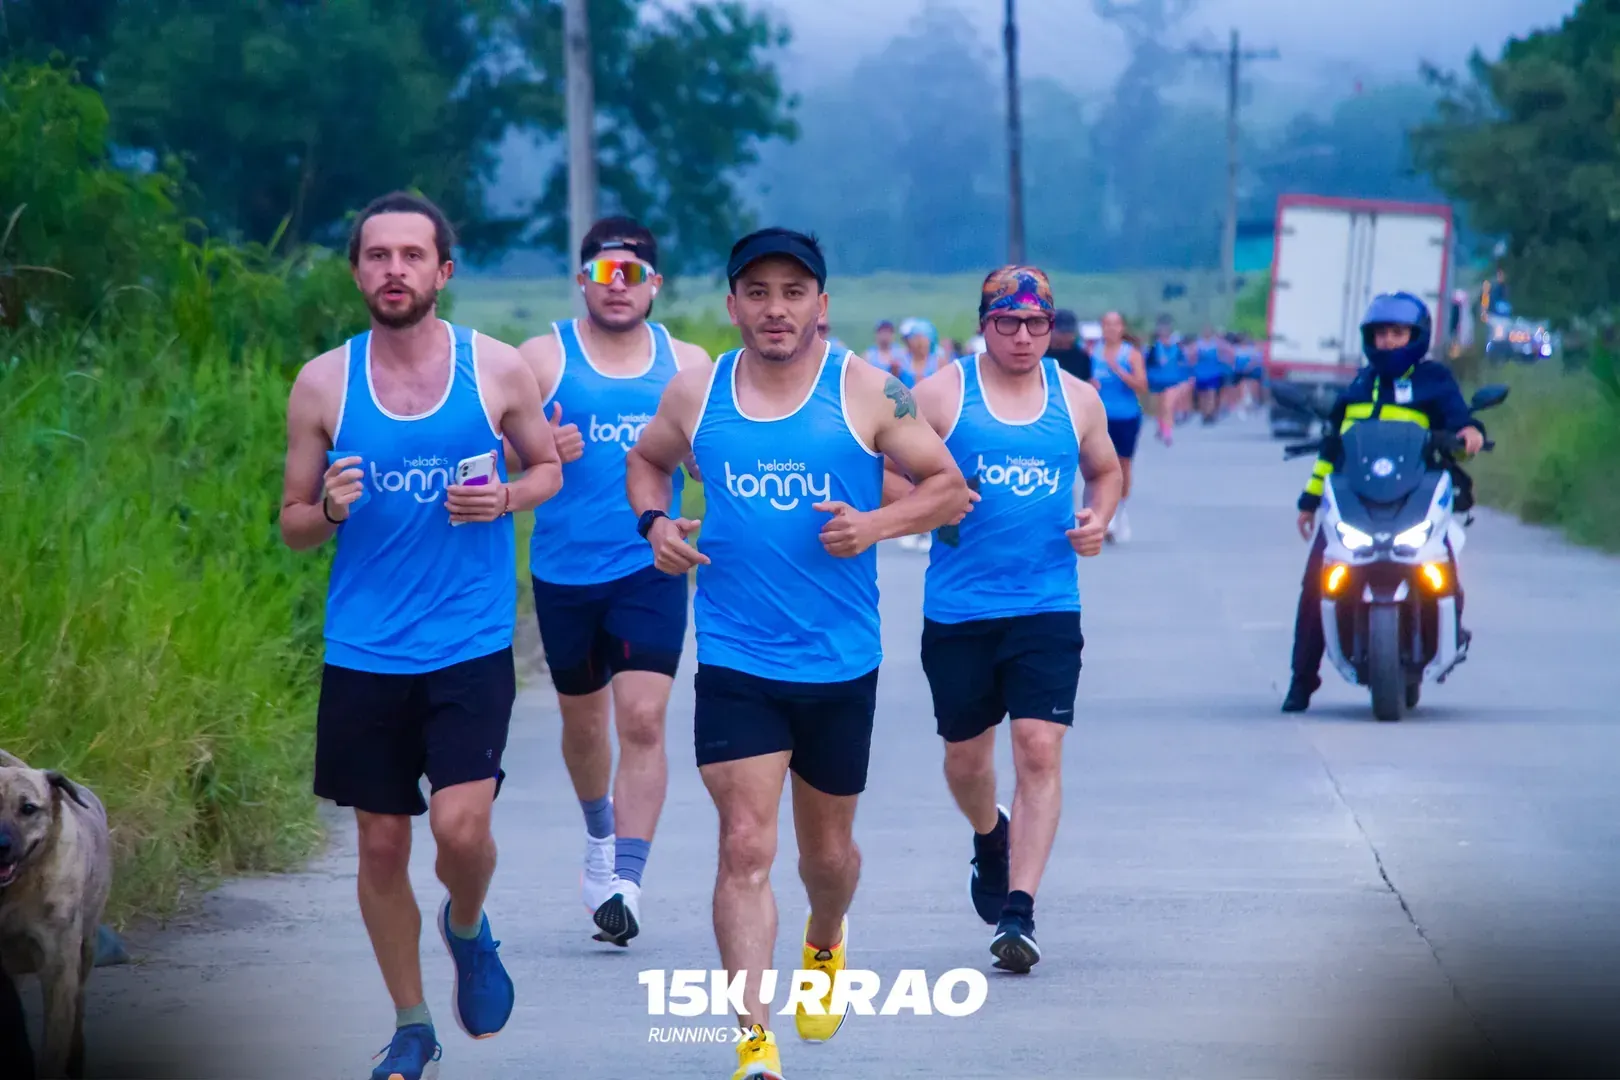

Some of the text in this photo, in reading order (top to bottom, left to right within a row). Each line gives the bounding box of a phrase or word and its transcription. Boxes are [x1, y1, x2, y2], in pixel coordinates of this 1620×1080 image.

[403, 454, 448, 467] helados
[757, 458, 806, 472] helados
[1005, 454, 1045, 467] helados
[975, 454, 1060, 494] tonny
[724, 461, 831, 503] tonny
